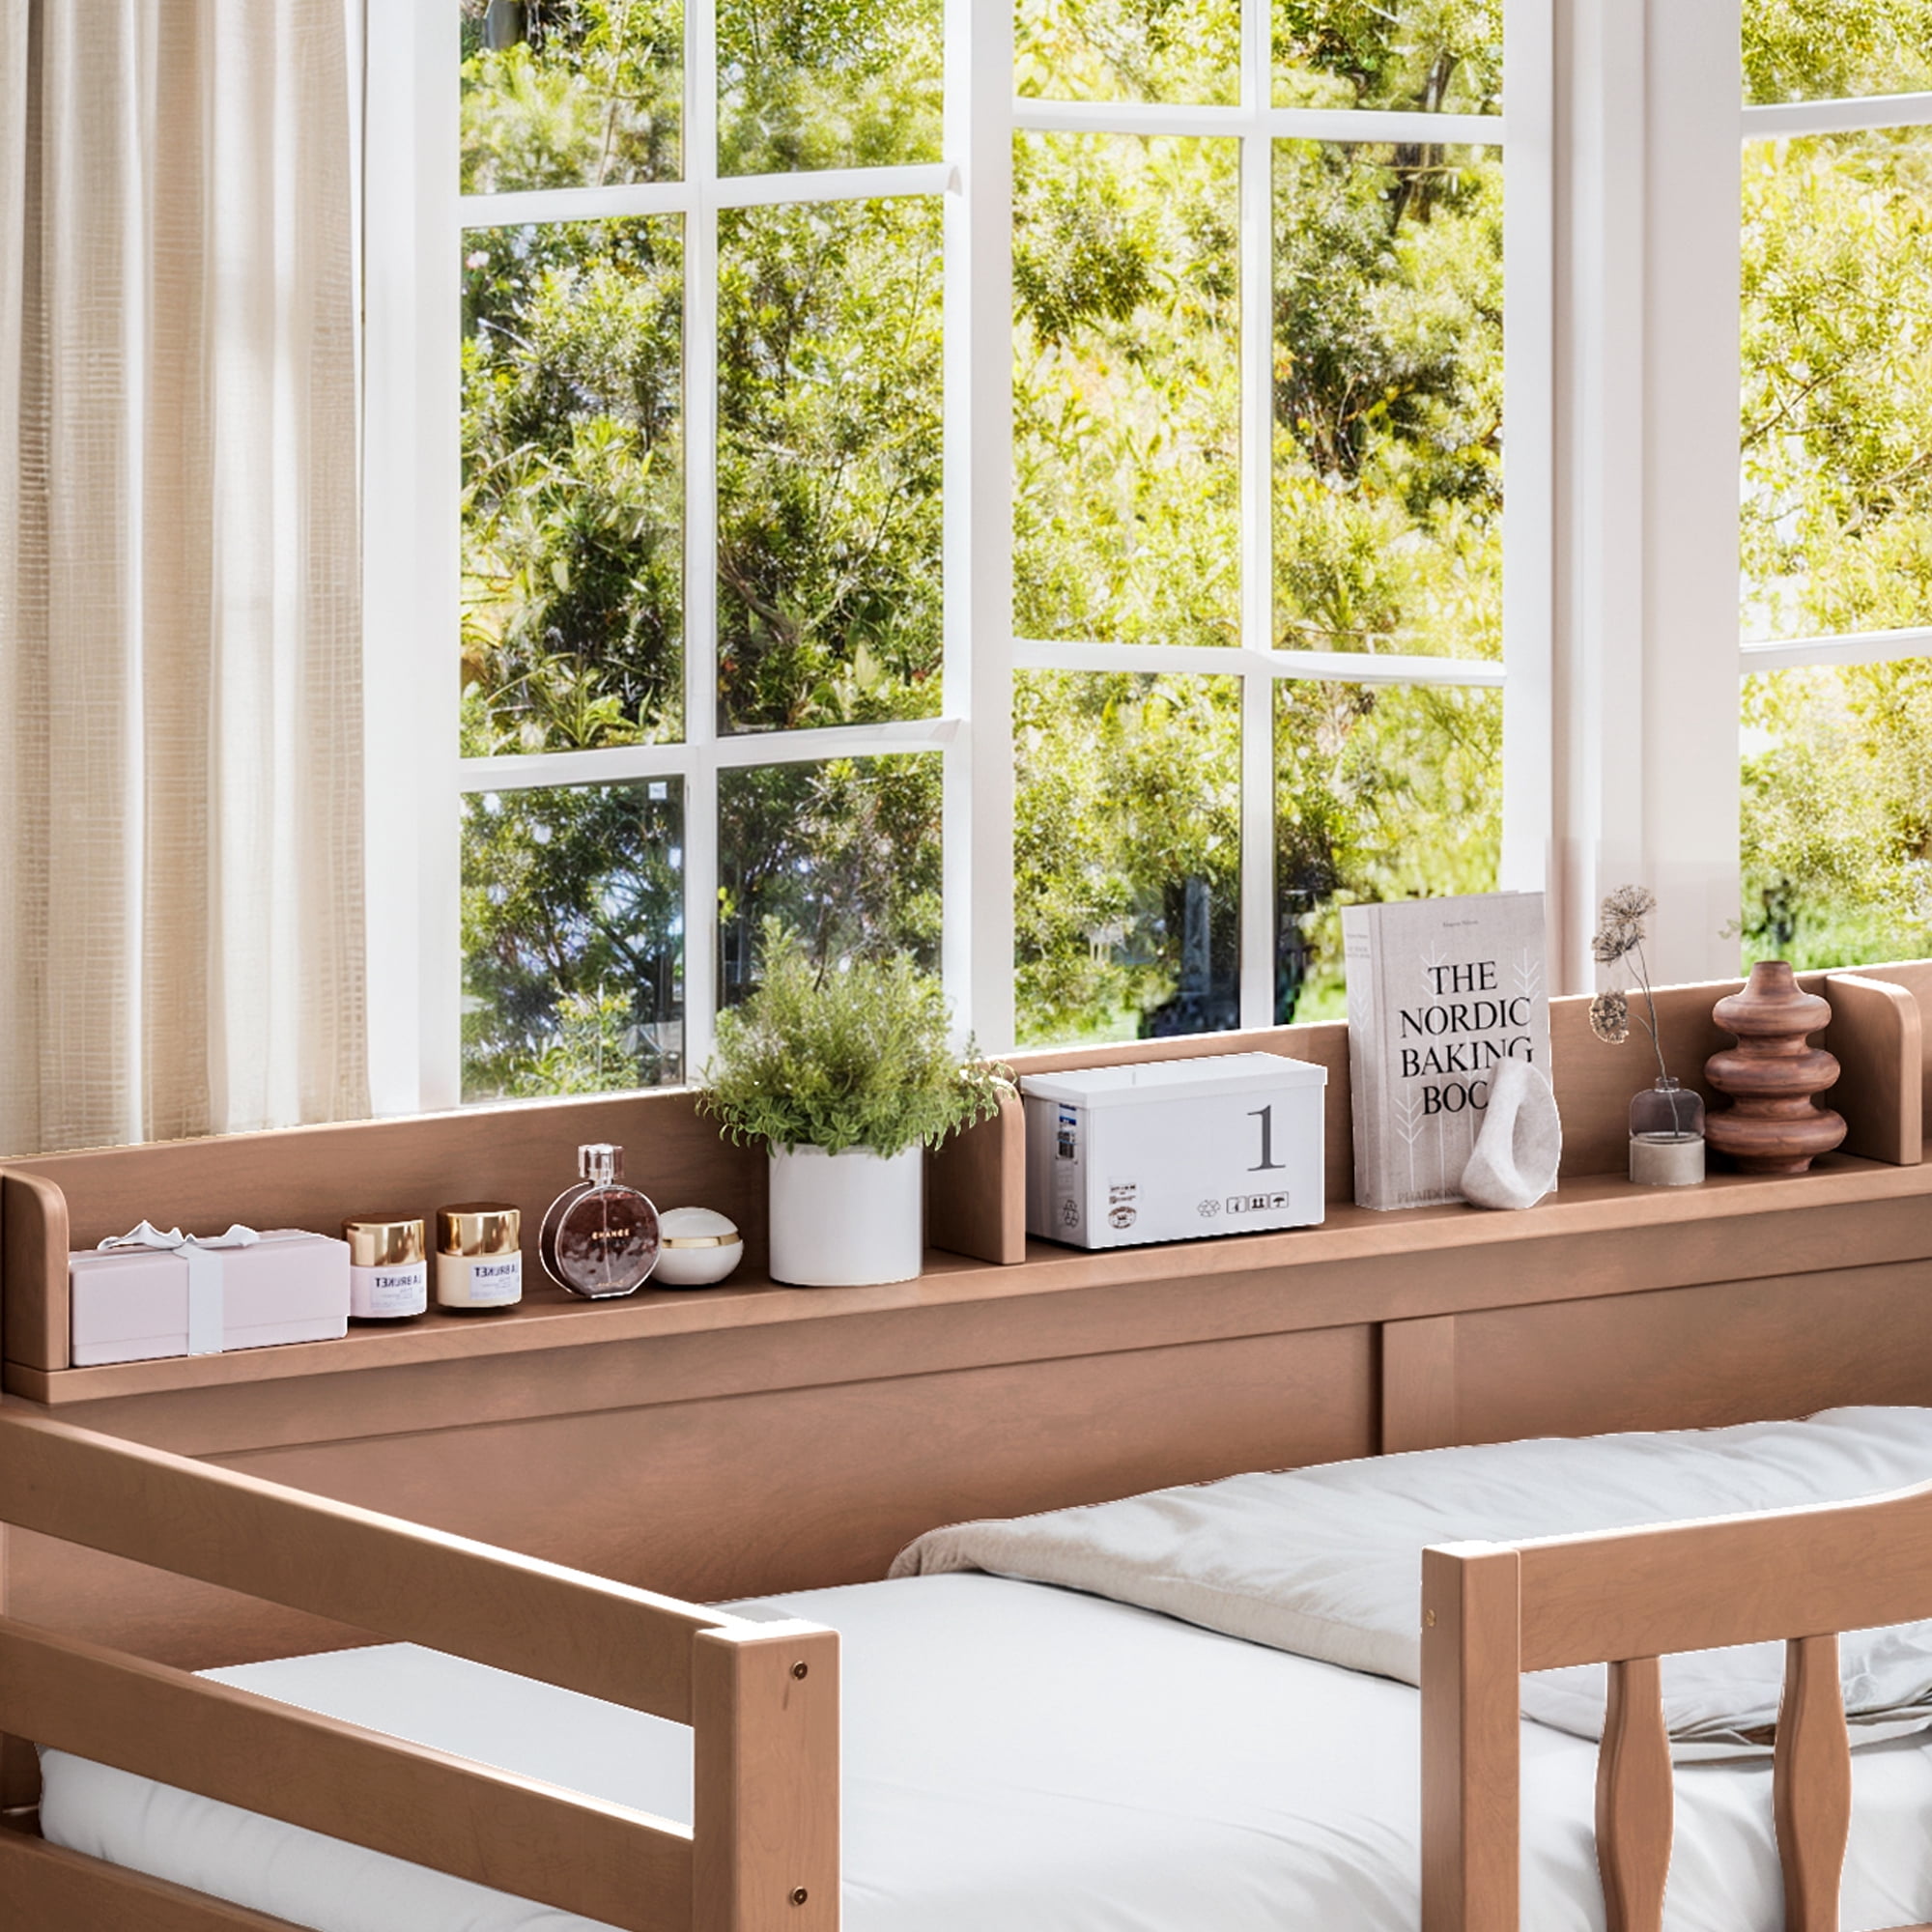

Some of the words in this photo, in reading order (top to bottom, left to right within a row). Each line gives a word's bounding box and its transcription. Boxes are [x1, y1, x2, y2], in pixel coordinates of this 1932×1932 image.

[1428, 960, 1497, 995] THE
[1399, 997, 1531, 1039] NORDIC
[1401, 1036, 1534, 1078] BAKING
[1422, 1080, 1489, 1116] BOO
[1247, 1104, 1286, 1172] 1
